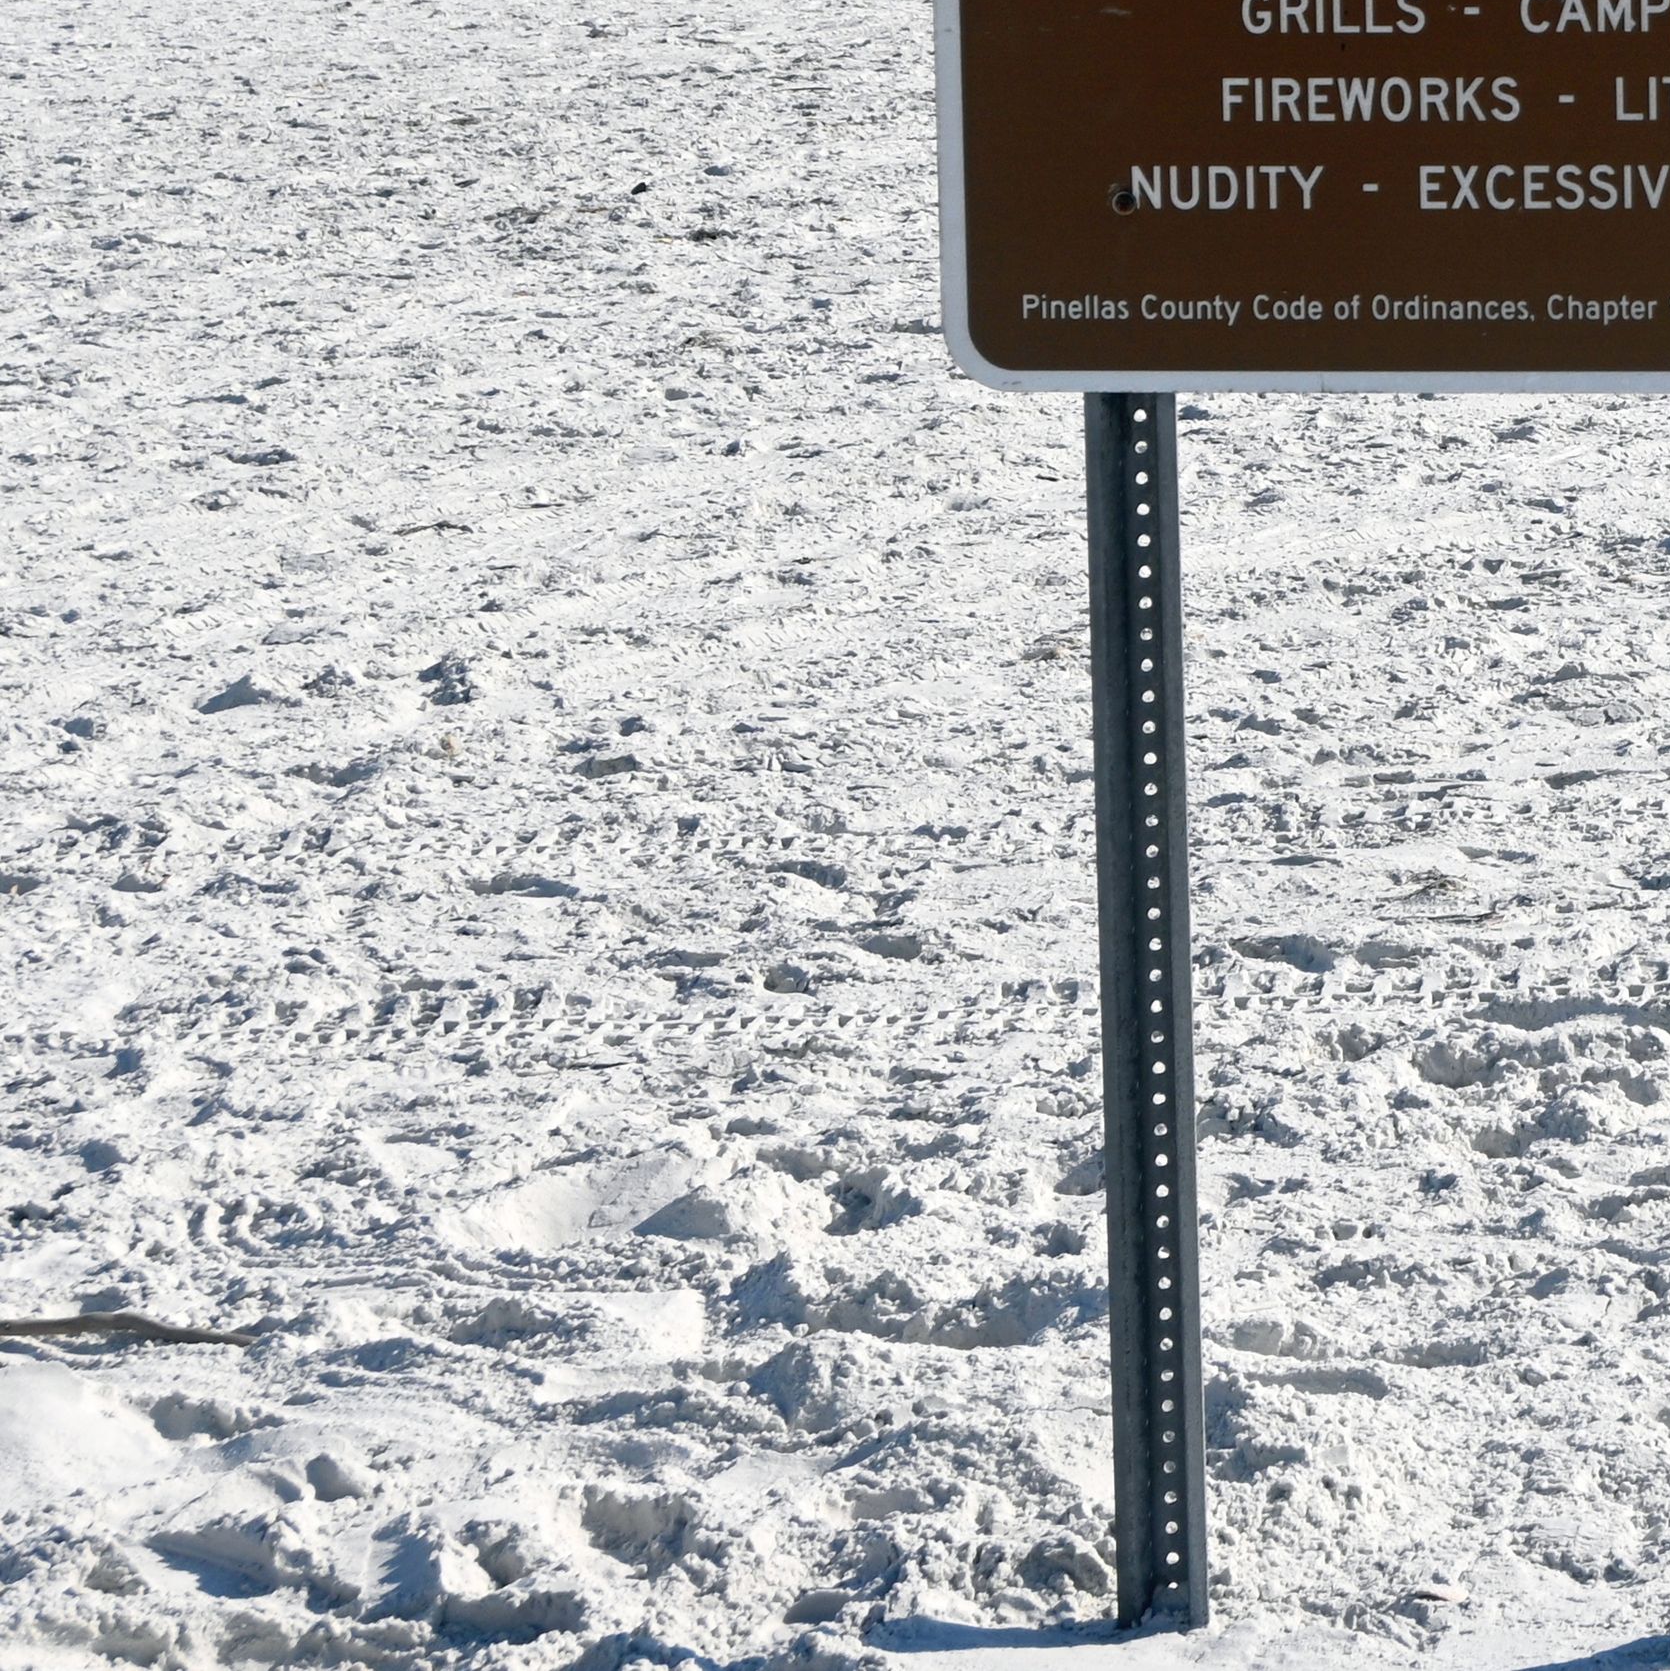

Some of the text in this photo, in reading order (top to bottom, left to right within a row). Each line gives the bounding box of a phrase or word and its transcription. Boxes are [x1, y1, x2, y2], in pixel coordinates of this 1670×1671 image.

[1222, 76, 1521, 122] FIREWORKS
[1130, 165, 1324, 210] NUDITY
[1022, 294, 1129, 320] Pinellas
[1141, 294, 1241, 326] County
[1253, 294, 1323, 320] Code
[1334, 294, 1360, 320] of
[1372, 294, 1535, 322] Ordinances,
[1547, 294, 1657, 325] Chapter
